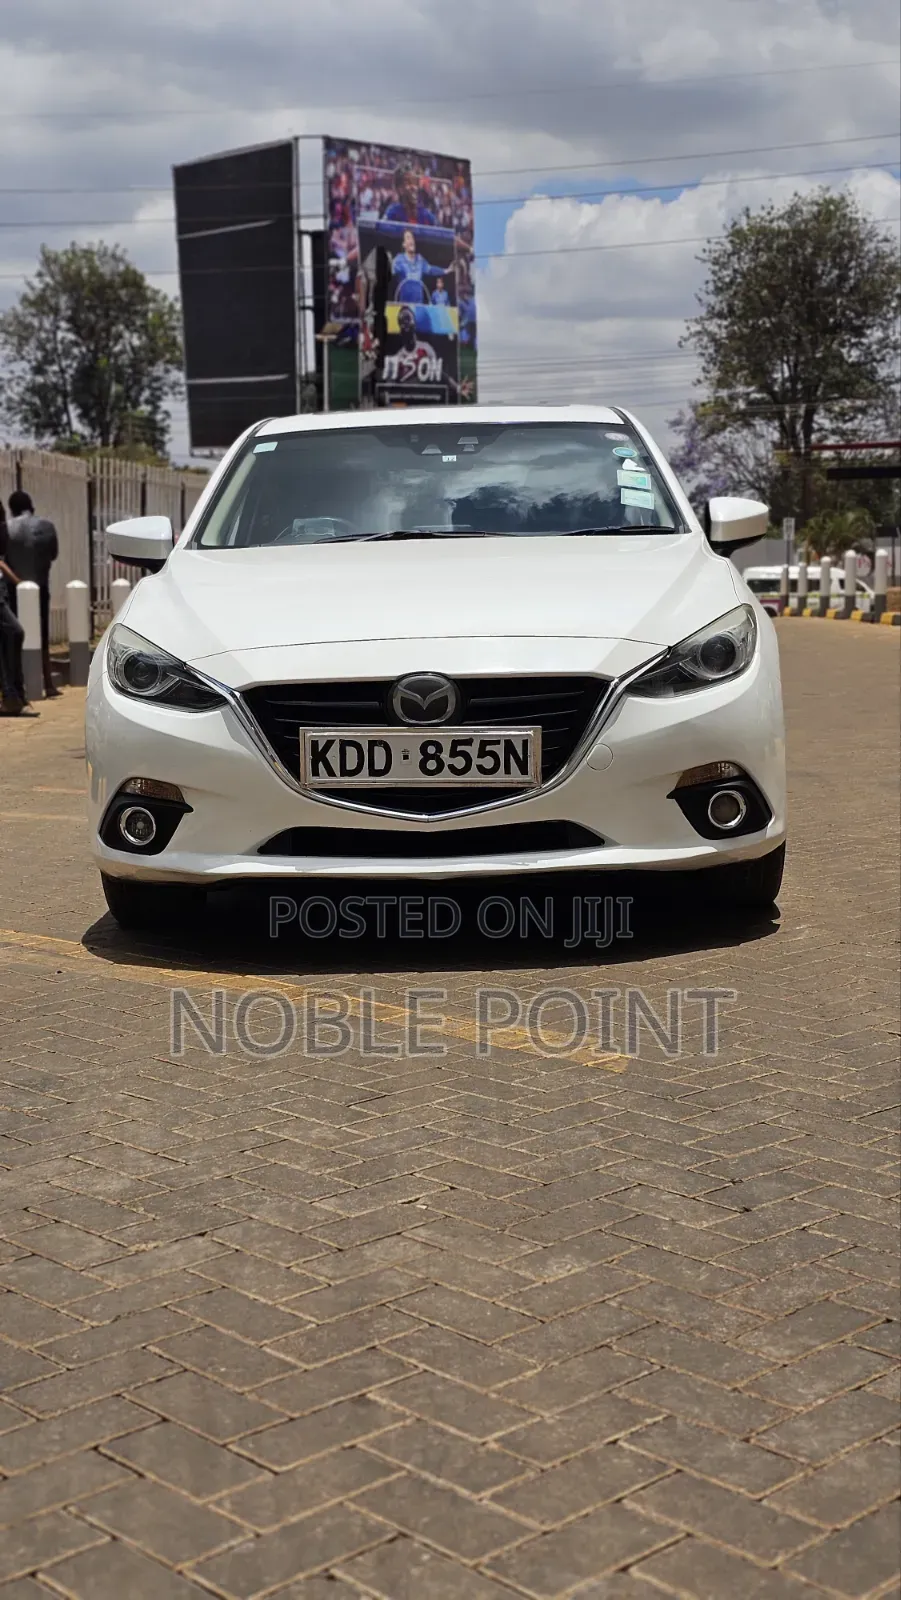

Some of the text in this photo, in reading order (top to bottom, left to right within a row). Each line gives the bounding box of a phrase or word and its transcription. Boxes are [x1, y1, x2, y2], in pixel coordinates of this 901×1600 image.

[417, 357, 442, 382] ON
[310, 738, 529, 777] KDD 855N
